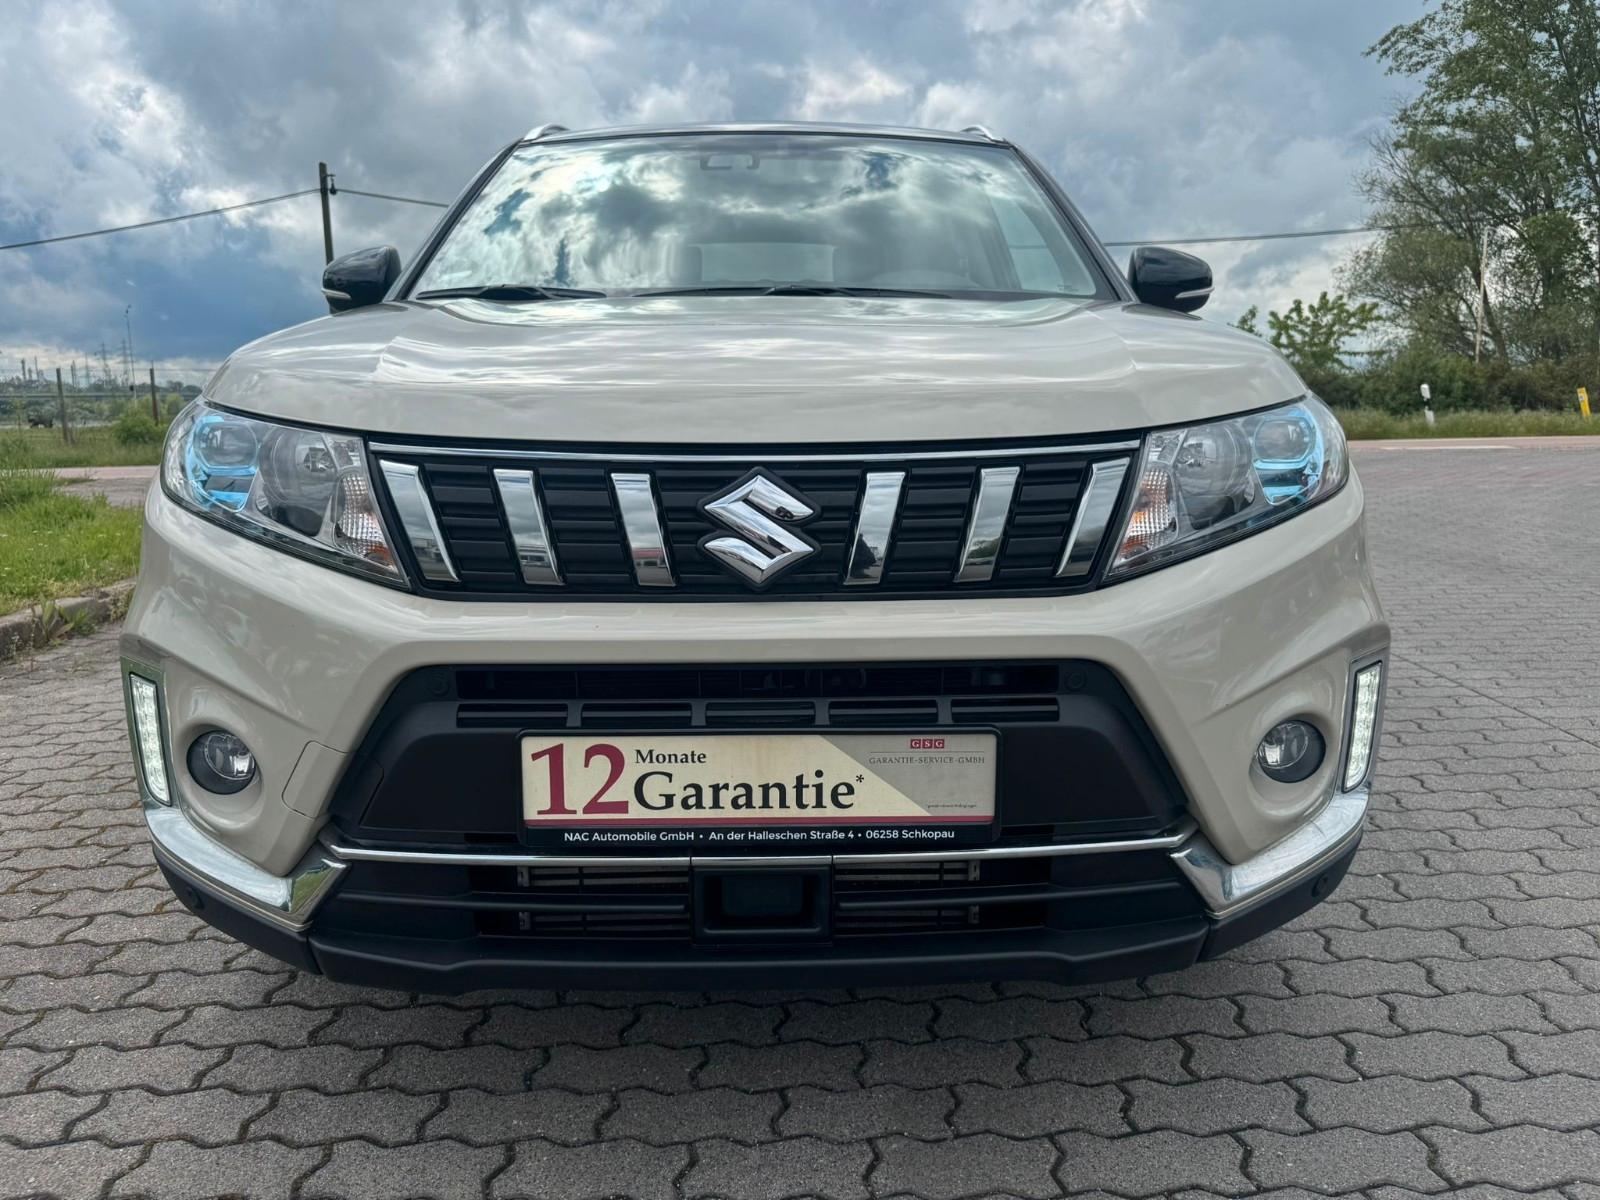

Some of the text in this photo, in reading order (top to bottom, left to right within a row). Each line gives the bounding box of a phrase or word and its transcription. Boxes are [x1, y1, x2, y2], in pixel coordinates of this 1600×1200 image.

[910, 739, 945, 749] GSG
[635, 749, 707, 764] Monate
[531, 743, 629, 815] 12
[564, 829, 955, 842] NAC Automobile GmbH An der Halleschen Straße 4 06258 Schkopau
